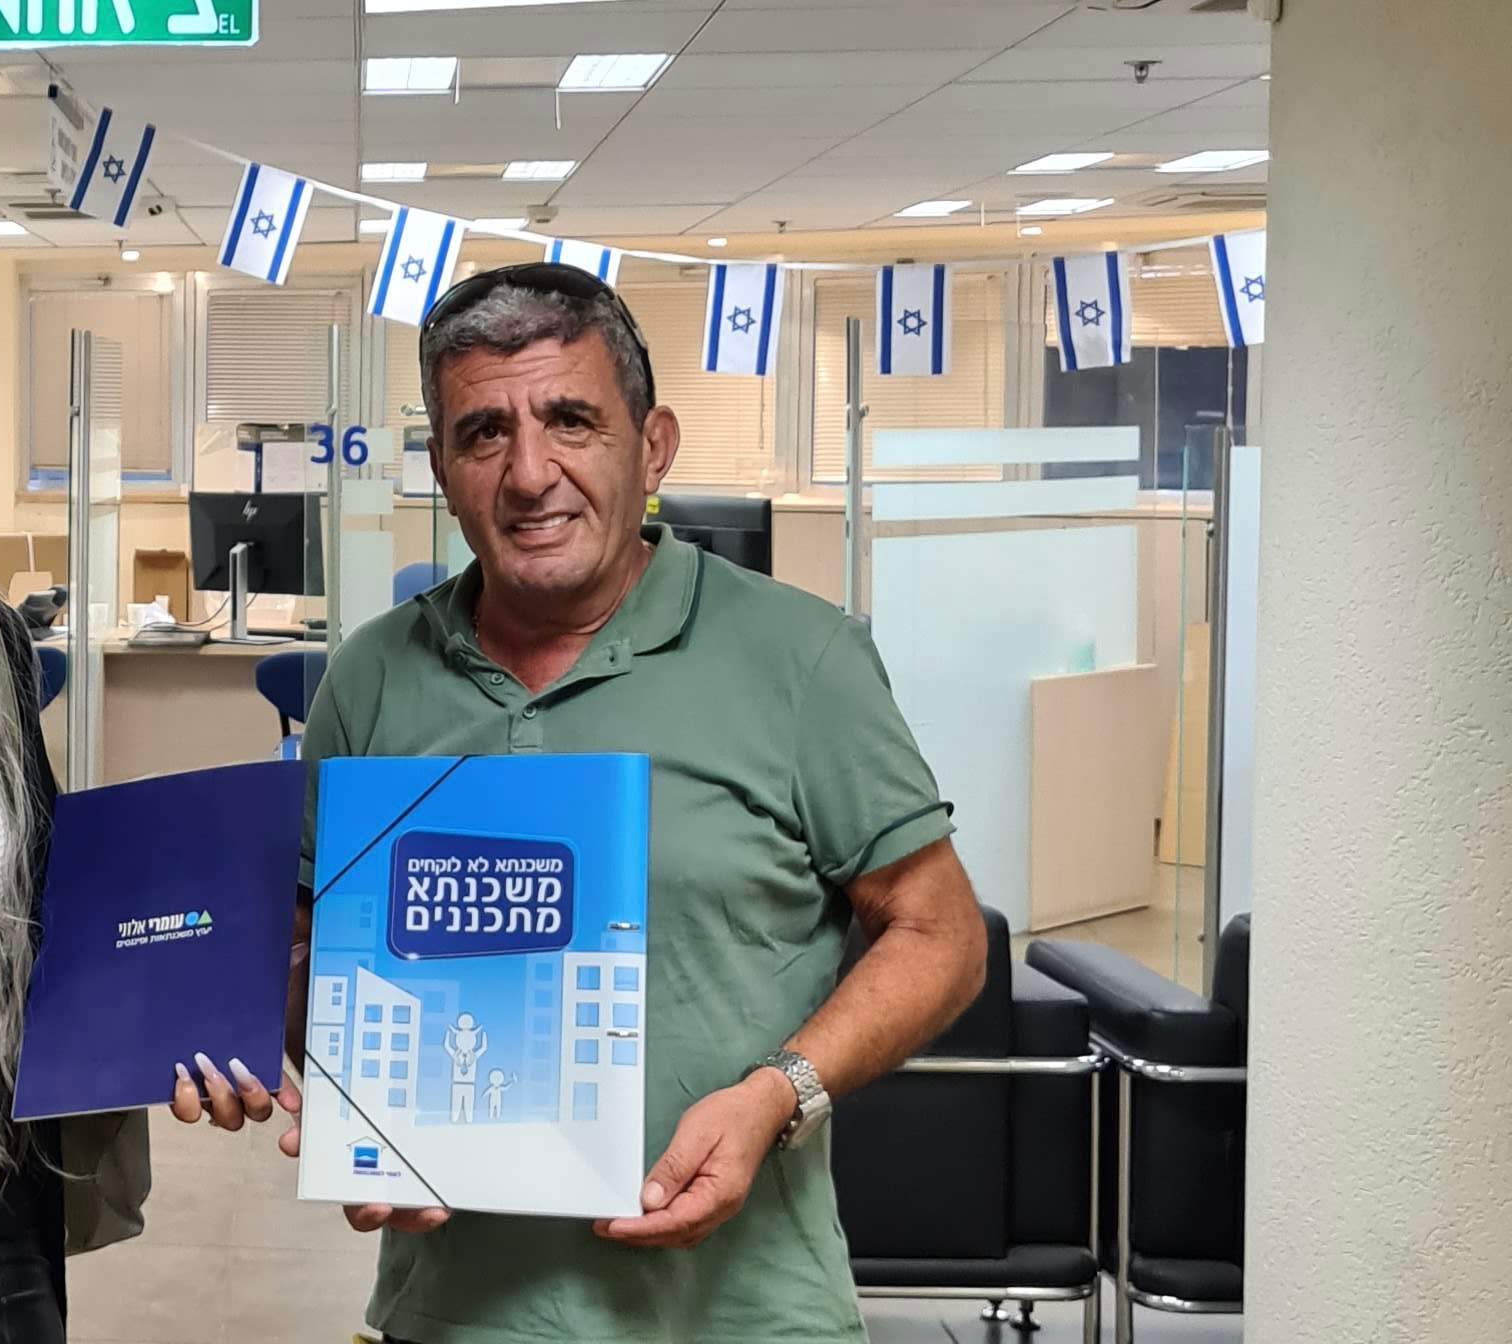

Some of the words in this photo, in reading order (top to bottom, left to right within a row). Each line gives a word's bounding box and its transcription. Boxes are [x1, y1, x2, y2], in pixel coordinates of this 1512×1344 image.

[218, 13, 241, 34] EL
[310, 423, 369, 466] 36
[407, 856, 461, 875] לוקחים
[467, 856, 489, 873] לא
[495, 858, 564, 873] משכנתא
[407, 876, 562, 903] משכנתא
[118, 918, 147, 938] אלוני
[148, 913, 185, 933] עומרי
[406, 905, 561, 934] מתכננים
